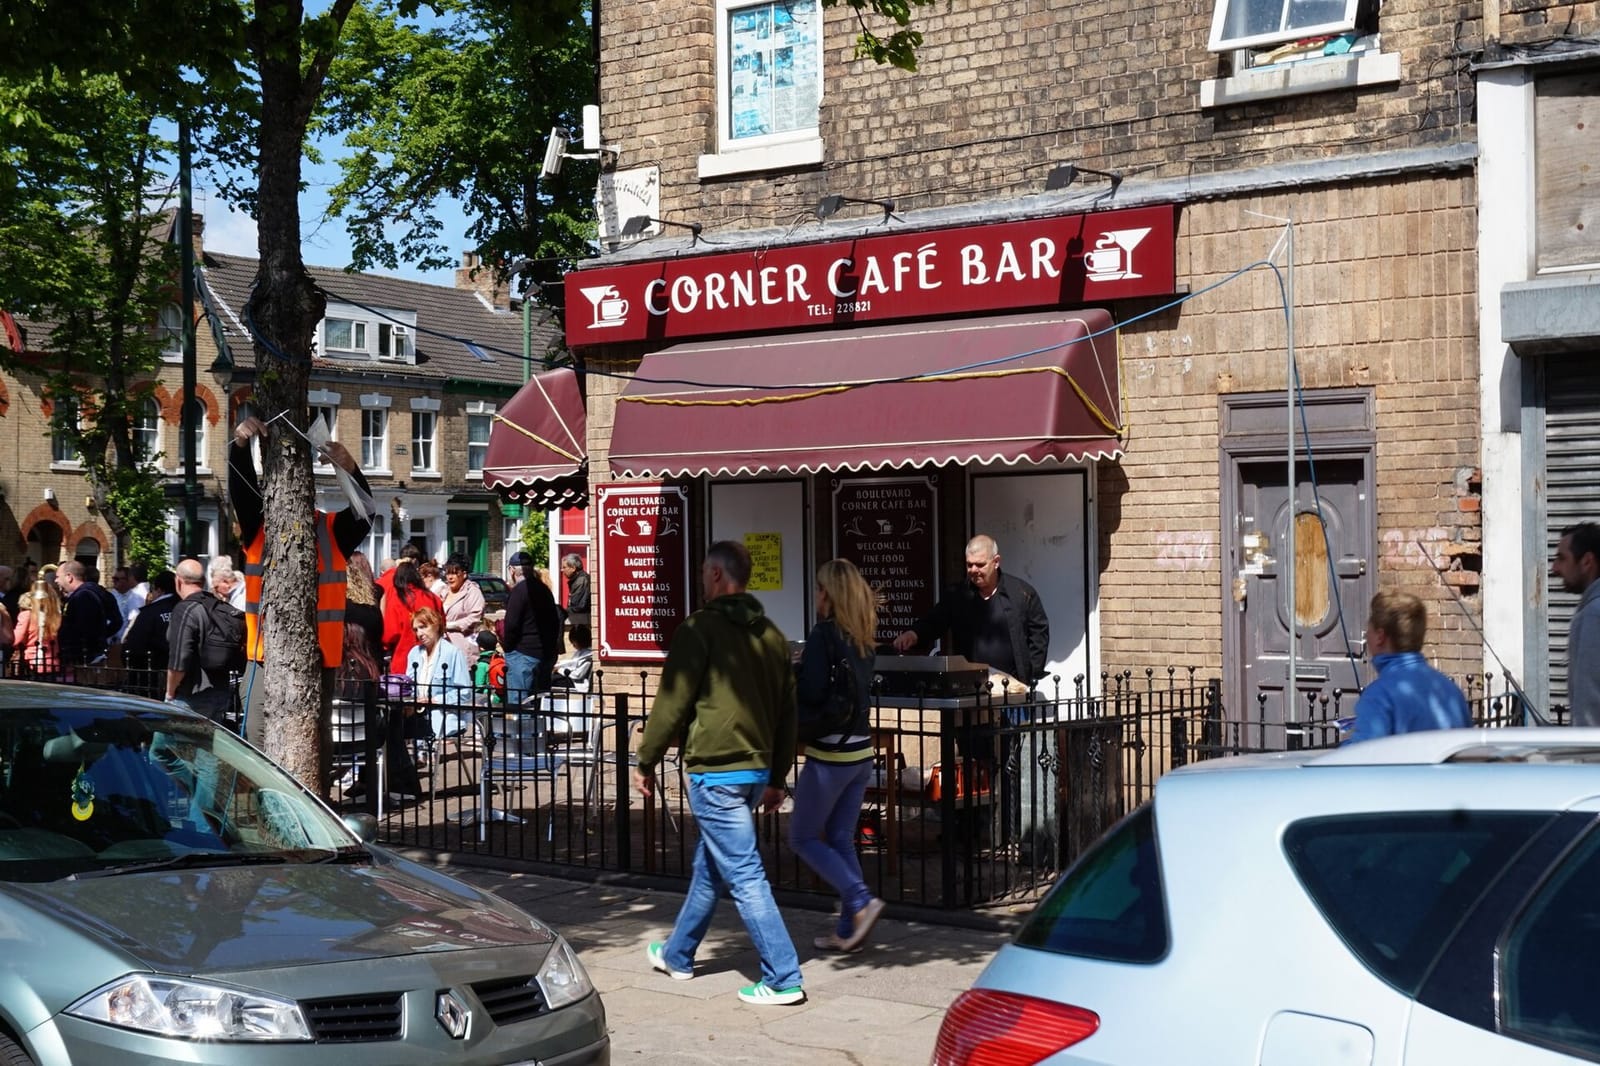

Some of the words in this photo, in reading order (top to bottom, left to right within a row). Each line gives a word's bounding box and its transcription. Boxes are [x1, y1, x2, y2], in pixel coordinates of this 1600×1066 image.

[644, 263, 811, 316] CORNER
[827, 242, 942, 298] CAFÉ
[960, 237, 1060, 286] BAR
[807, 303, 832, 316] TEL:
[837, 300, 871, 314] 228821
[856, 488, 911, 499] BOULEVARD
[619, 496, 666, 505] BOULEVARD
[842, 500, 879, 511] CORNER
[907, 499, 927, 509] BAR
[606, 506, 639, 517] CORNER
[662, 506, 679, 515] BAR
[856, 542, 894, 551] WELCOME
[896, 541, 911, 550] ALL
[624, 558, 664, 567] BAGUETTES
[863, 554, 879, 563] FINE
[881, 554, 905, 563] FOOD
[632, 570, 657, 579] WRAPS
[859, 567, 879, 576] BEER
[881, 567, 886, 575] &
[888, 566, 909, 576] WINE
[619, 582, 640, 592] PASTA
[641, 582, 671, 592] SALADS
[894, 579, 925, 588] DRINKS
[621, 595, 645, 604] SALAD
[647, 595, 668, 604] TRAYS
[887, 592, 914, 601] INSIDE
[615, 607, 639, 617] BAKED
[641, 607, 676, 617] POTATOES
[893, 604, 912, 613] AWAY
[631, 620, 659, 629] SNACKS
[628, 633, 664, 642] DESSERTS
